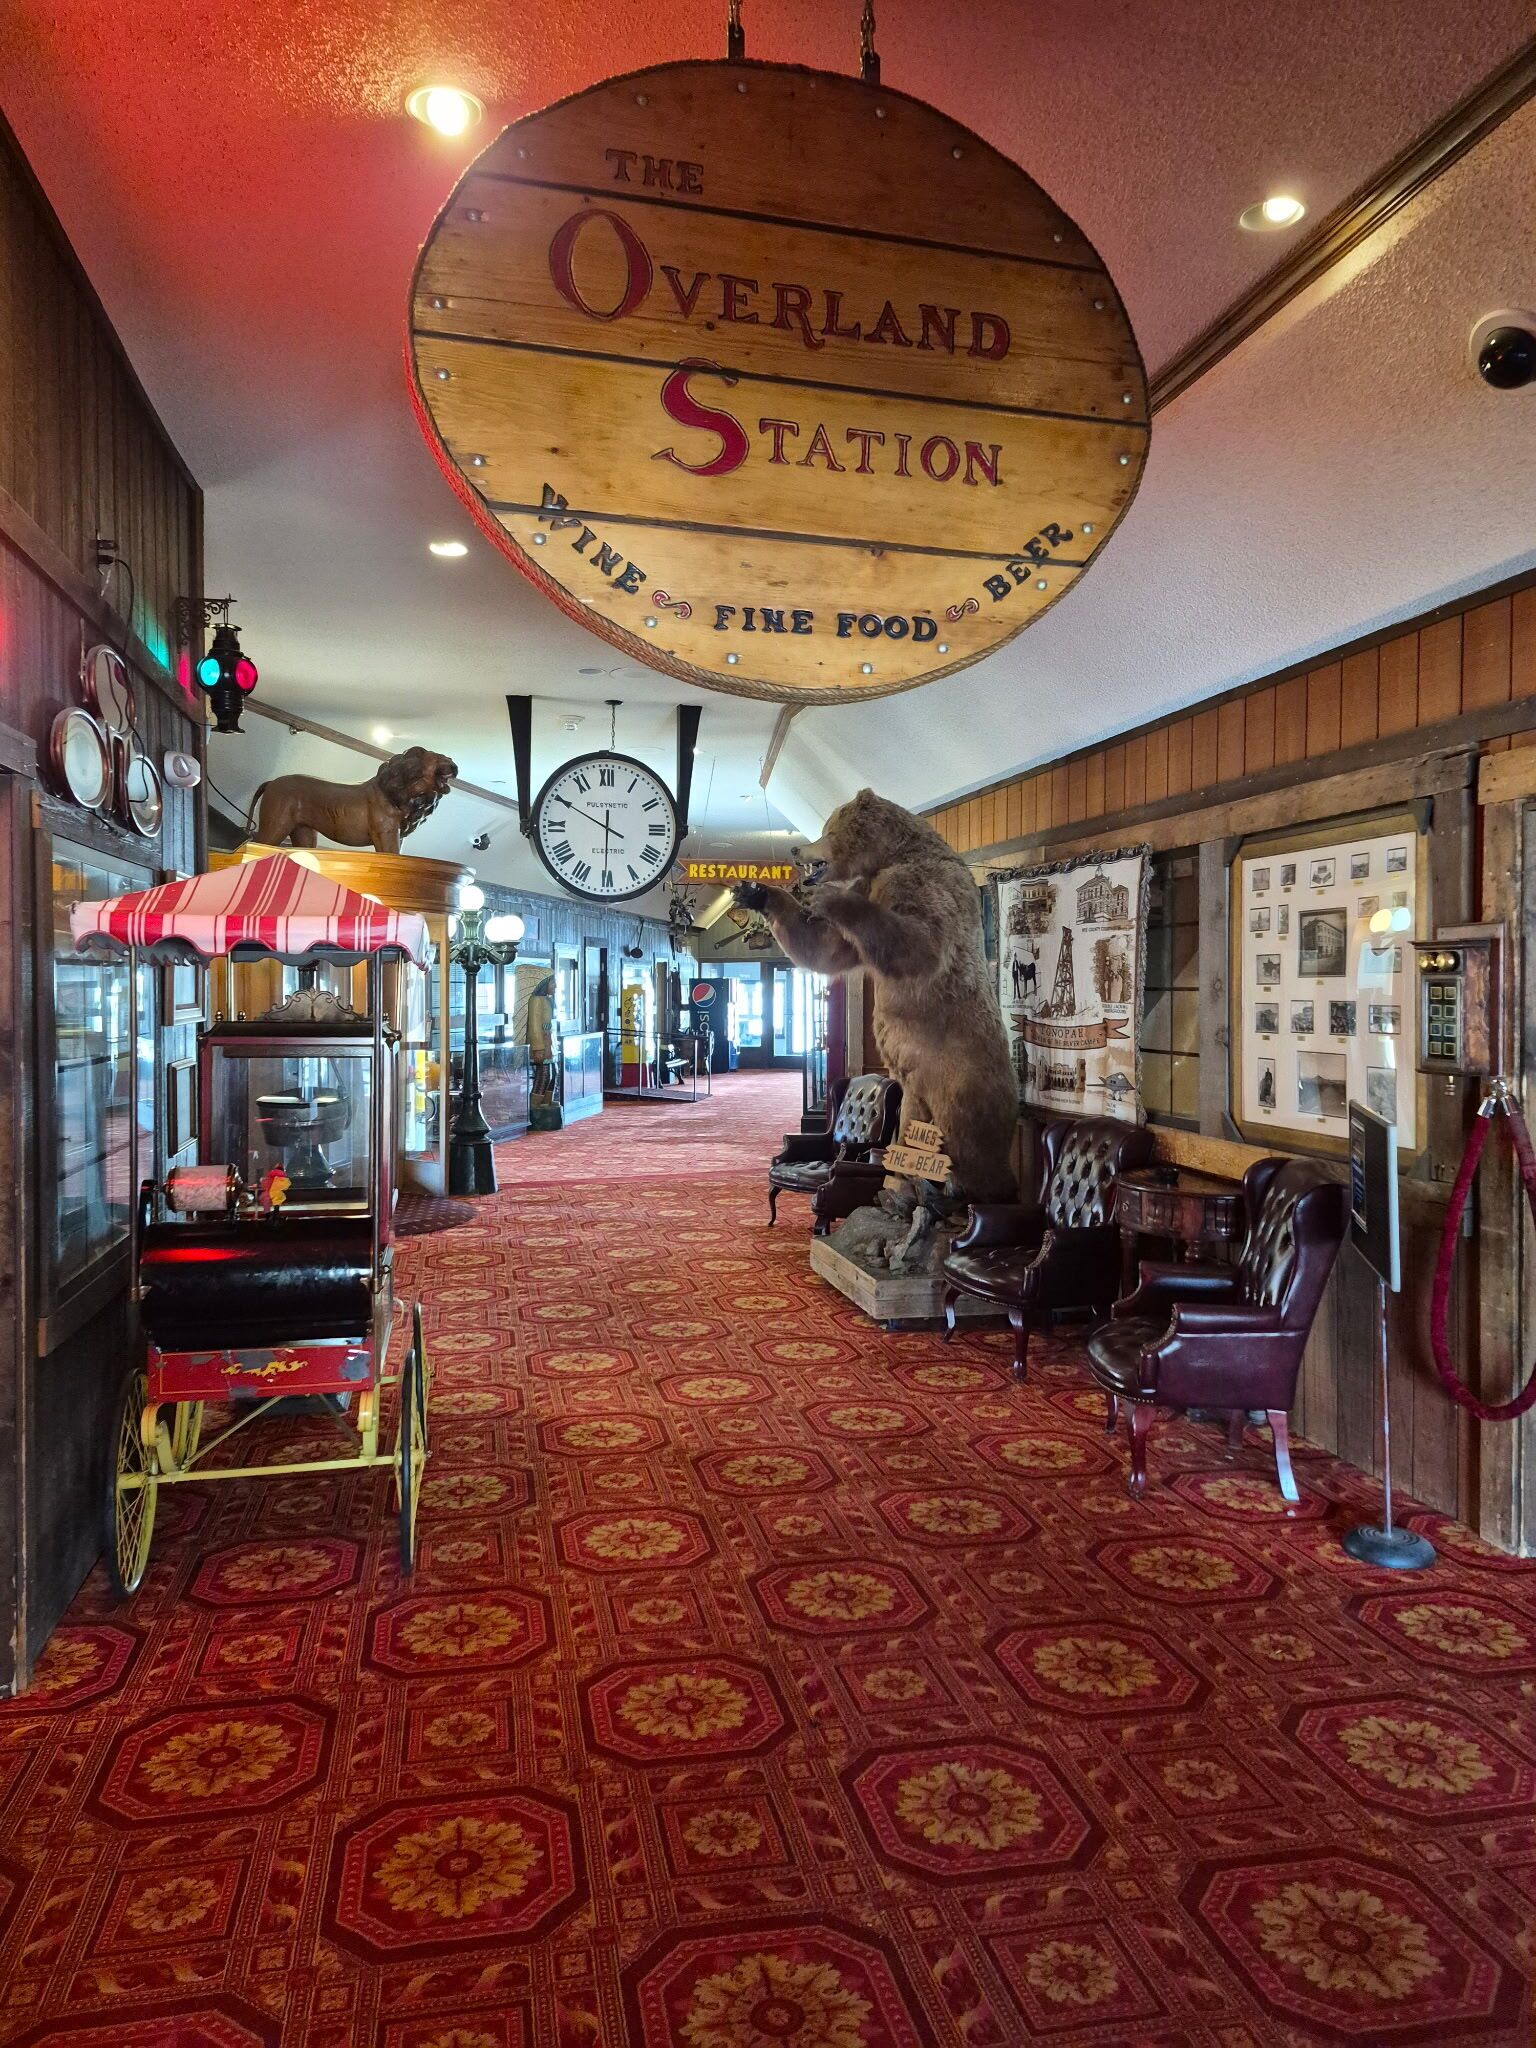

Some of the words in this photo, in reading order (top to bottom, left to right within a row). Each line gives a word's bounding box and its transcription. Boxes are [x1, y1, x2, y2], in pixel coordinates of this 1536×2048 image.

[605, 148, 704, 195] THE
[549, 208, 1011, 360] OVERLAND
[651, 357, 1003, 487] STATION
[538, 482, 647, 595] WINE
[713, 604, 814, 635] FINE
[837, 612, 938, 642] FOOD
[982, 522, 1074, 603] BEER
[599, 768, 615, 787] XII
[586, 801, 628, 809] PULSYNETIC
[591, 847, 625, 855] ELECTRIC
[689, 863, 793, 880] RESTAURANT
[1039, 1026, 1084, 1039] TONOPAH
[908, 1126, 938, 1146] JAMES
[889, 1149, 908, 1168] THE
[915, 1155, 945, 1176] BEAR
